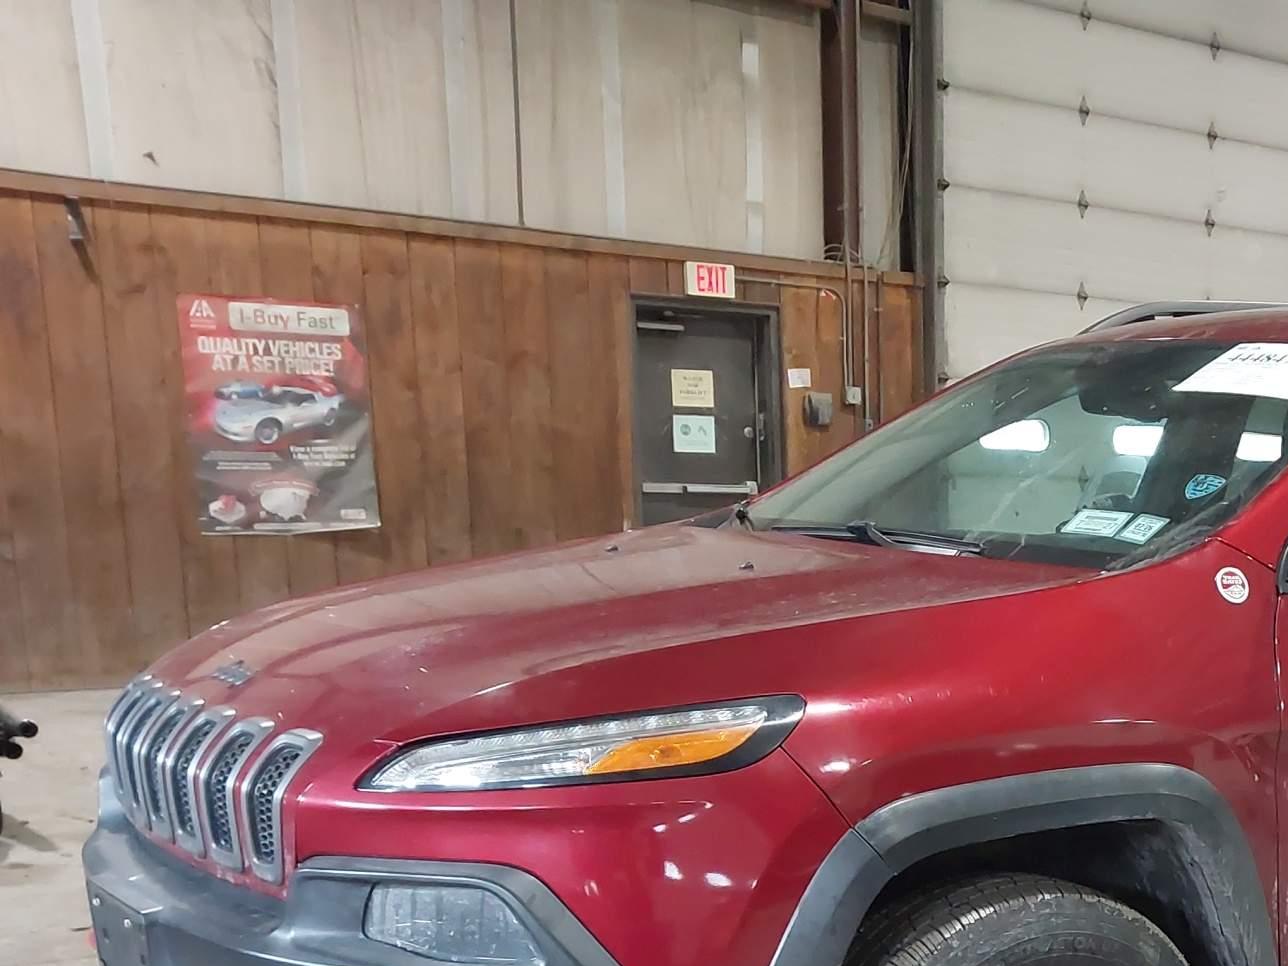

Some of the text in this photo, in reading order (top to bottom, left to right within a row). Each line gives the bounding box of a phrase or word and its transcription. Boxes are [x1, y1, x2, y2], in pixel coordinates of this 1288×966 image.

[696, 264, 727, 294] EXIT
[239, 308, 290, 329] I-Buy
[296, 311, 336, 330] Fast
[197, 335, 342, 360] QUALITY VEHICLES
[211, 354, 336, 377] AT A SET PRICE!
